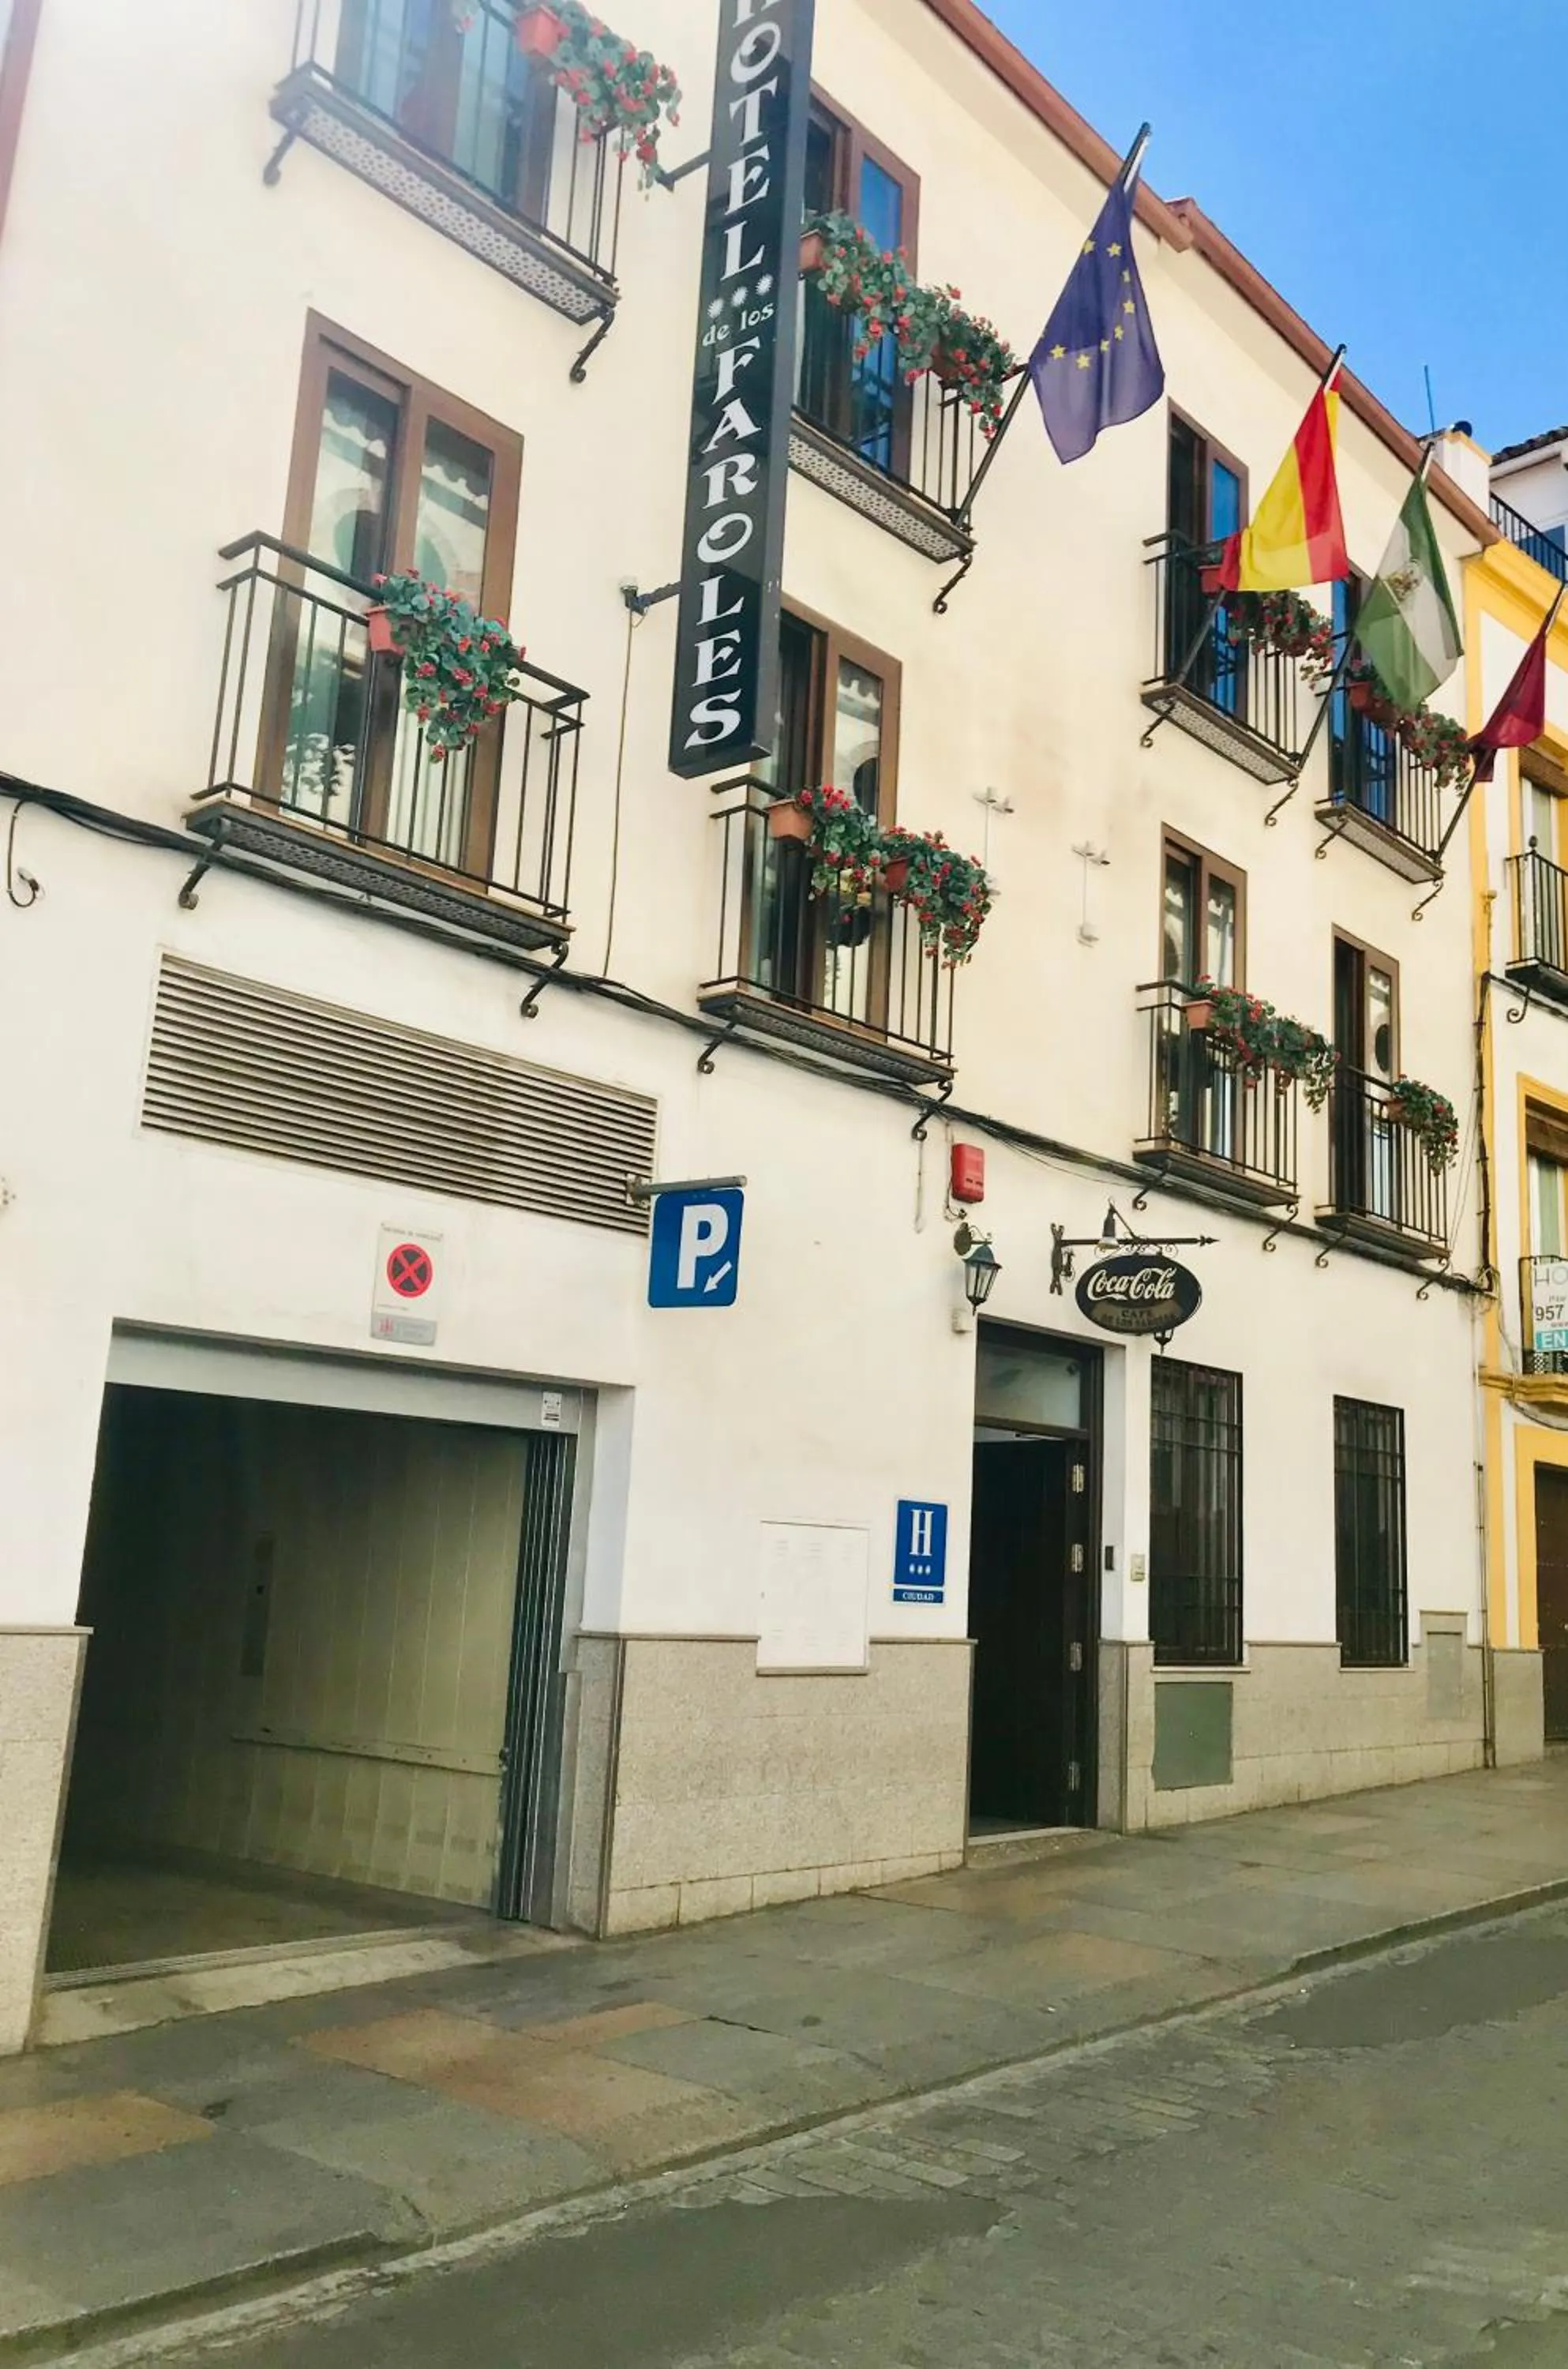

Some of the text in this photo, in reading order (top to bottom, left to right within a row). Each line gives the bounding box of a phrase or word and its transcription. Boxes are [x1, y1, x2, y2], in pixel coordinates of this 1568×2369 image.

[702, 302, 775, 347] de los
[685, 338, 761, 749] FAROLES
[677, 1203, 729, 1290] P
[1536, 1304, 1564, 1321] 957
[909, 1509, 935, 1556] H
[902, 1590, 935, 1601] CIUDAD
